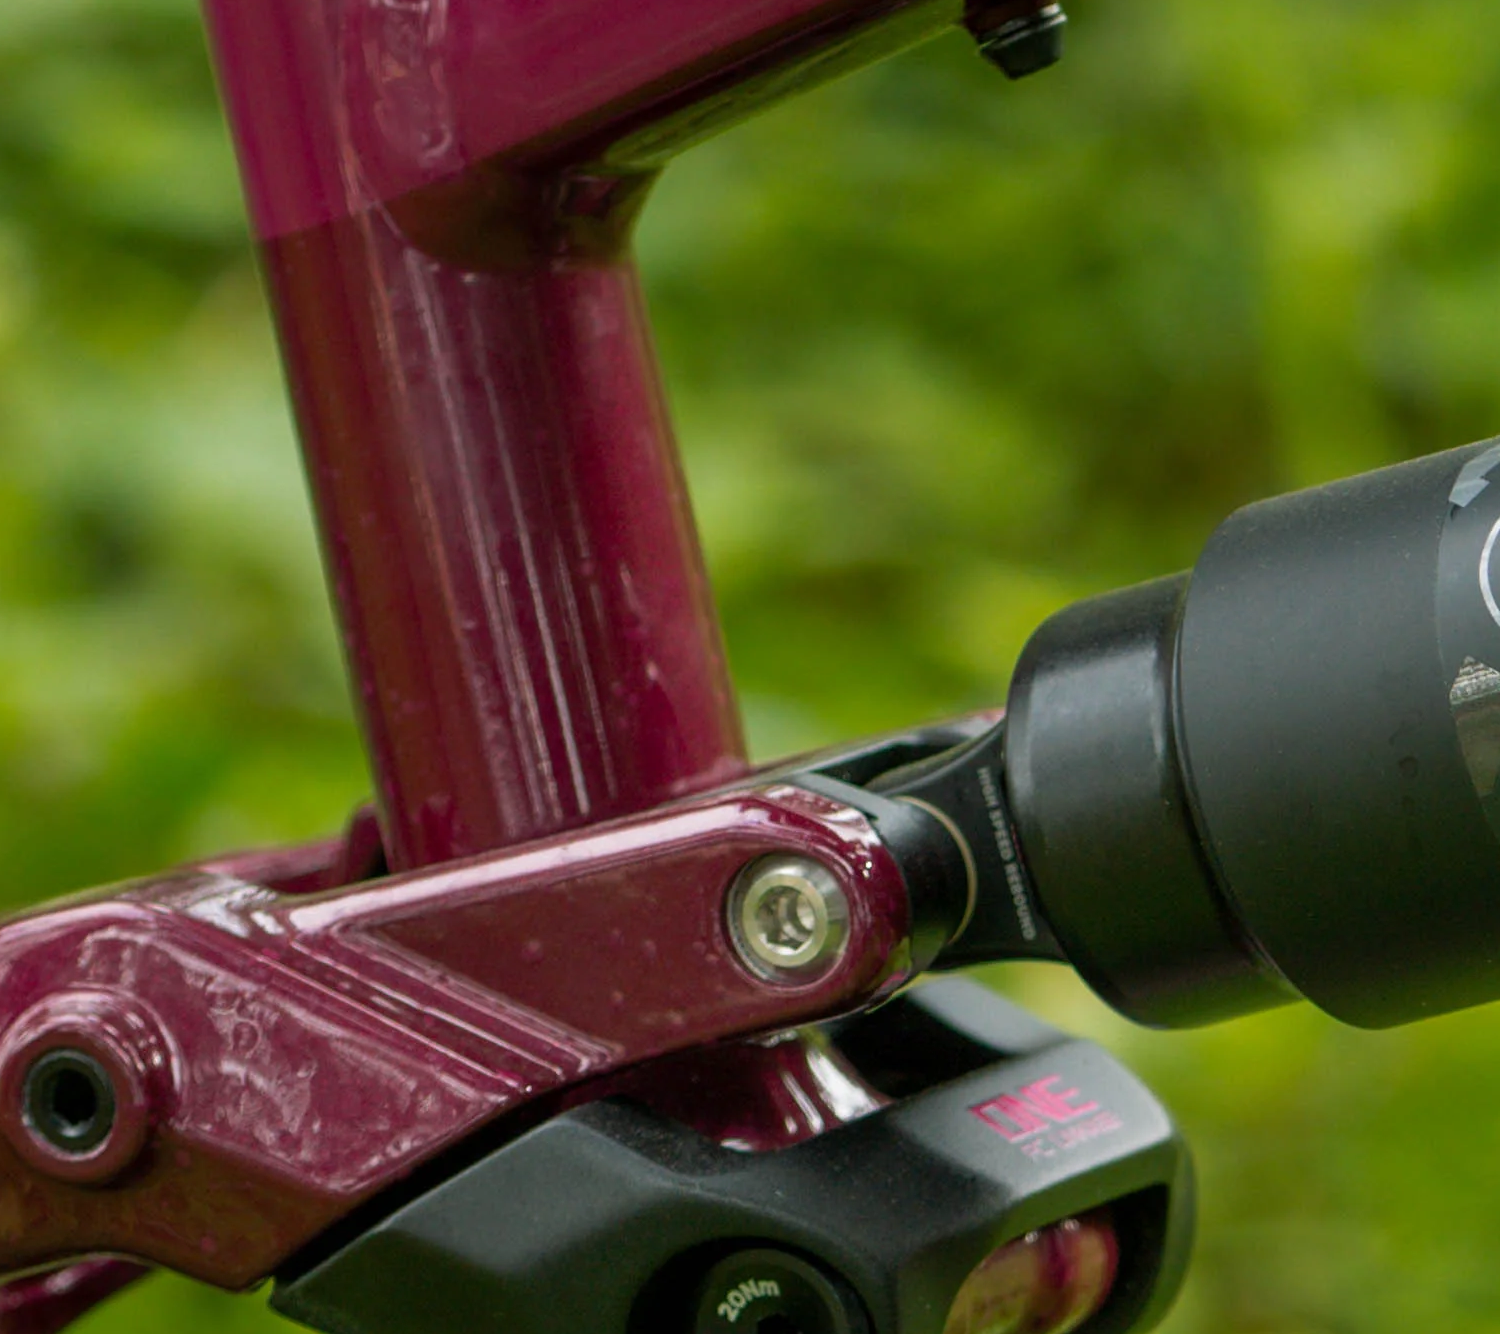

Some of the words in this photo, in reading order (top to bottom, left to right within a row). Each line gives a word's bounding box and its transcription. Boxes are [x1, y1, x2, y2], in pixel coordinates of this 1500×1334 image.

[977, 767, 999, 808] HIGH
[989, 808, 1014, 861] SPEED
[1005, 863, 1037, 941] REBOUND
[717, 1278, 781, 1323] 20Nm
